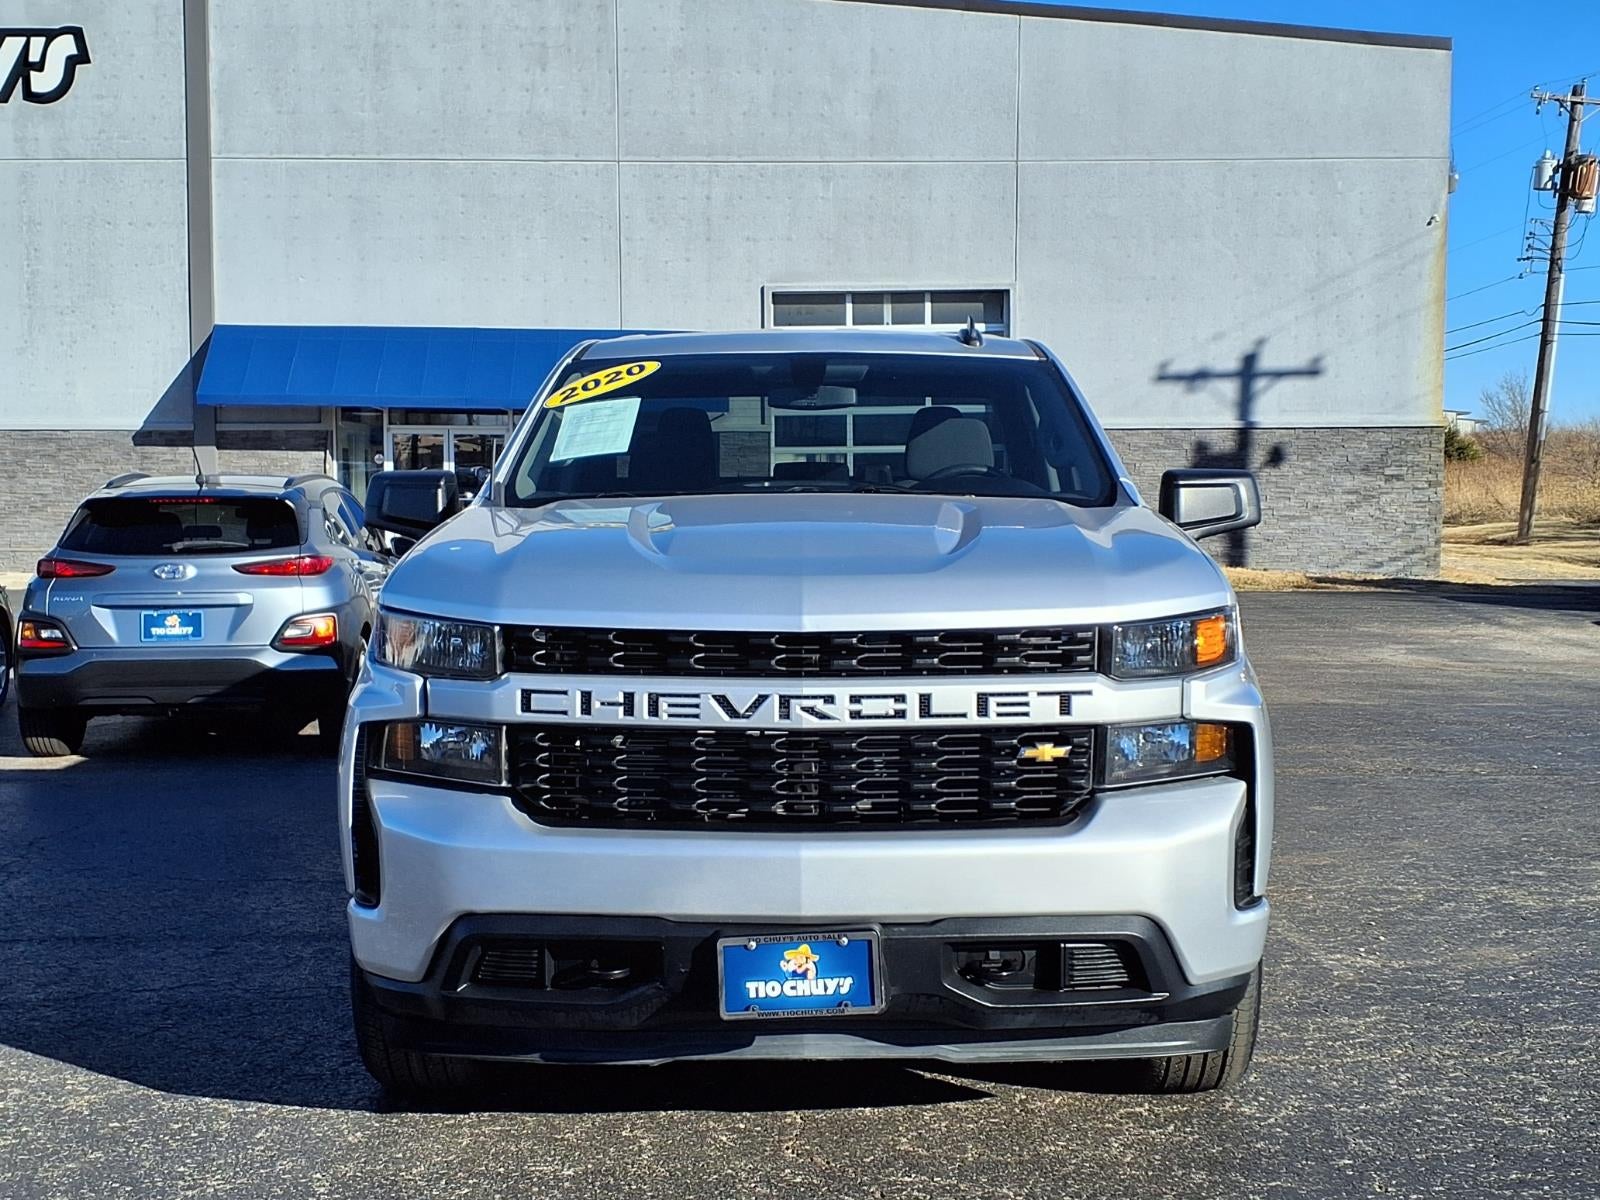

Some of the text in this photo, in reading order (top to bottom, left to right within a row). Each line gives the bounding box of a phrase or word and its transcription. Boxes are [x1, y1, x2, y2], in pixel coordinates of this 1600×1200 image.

[558, 363, 647, 403] 2020
[517, 689, 1094, 720] CHEVROLET
[796, 934, 819, 942] AUTO
[757, 1007, 846, 1018] WWW.TIOCHUYS.COM
